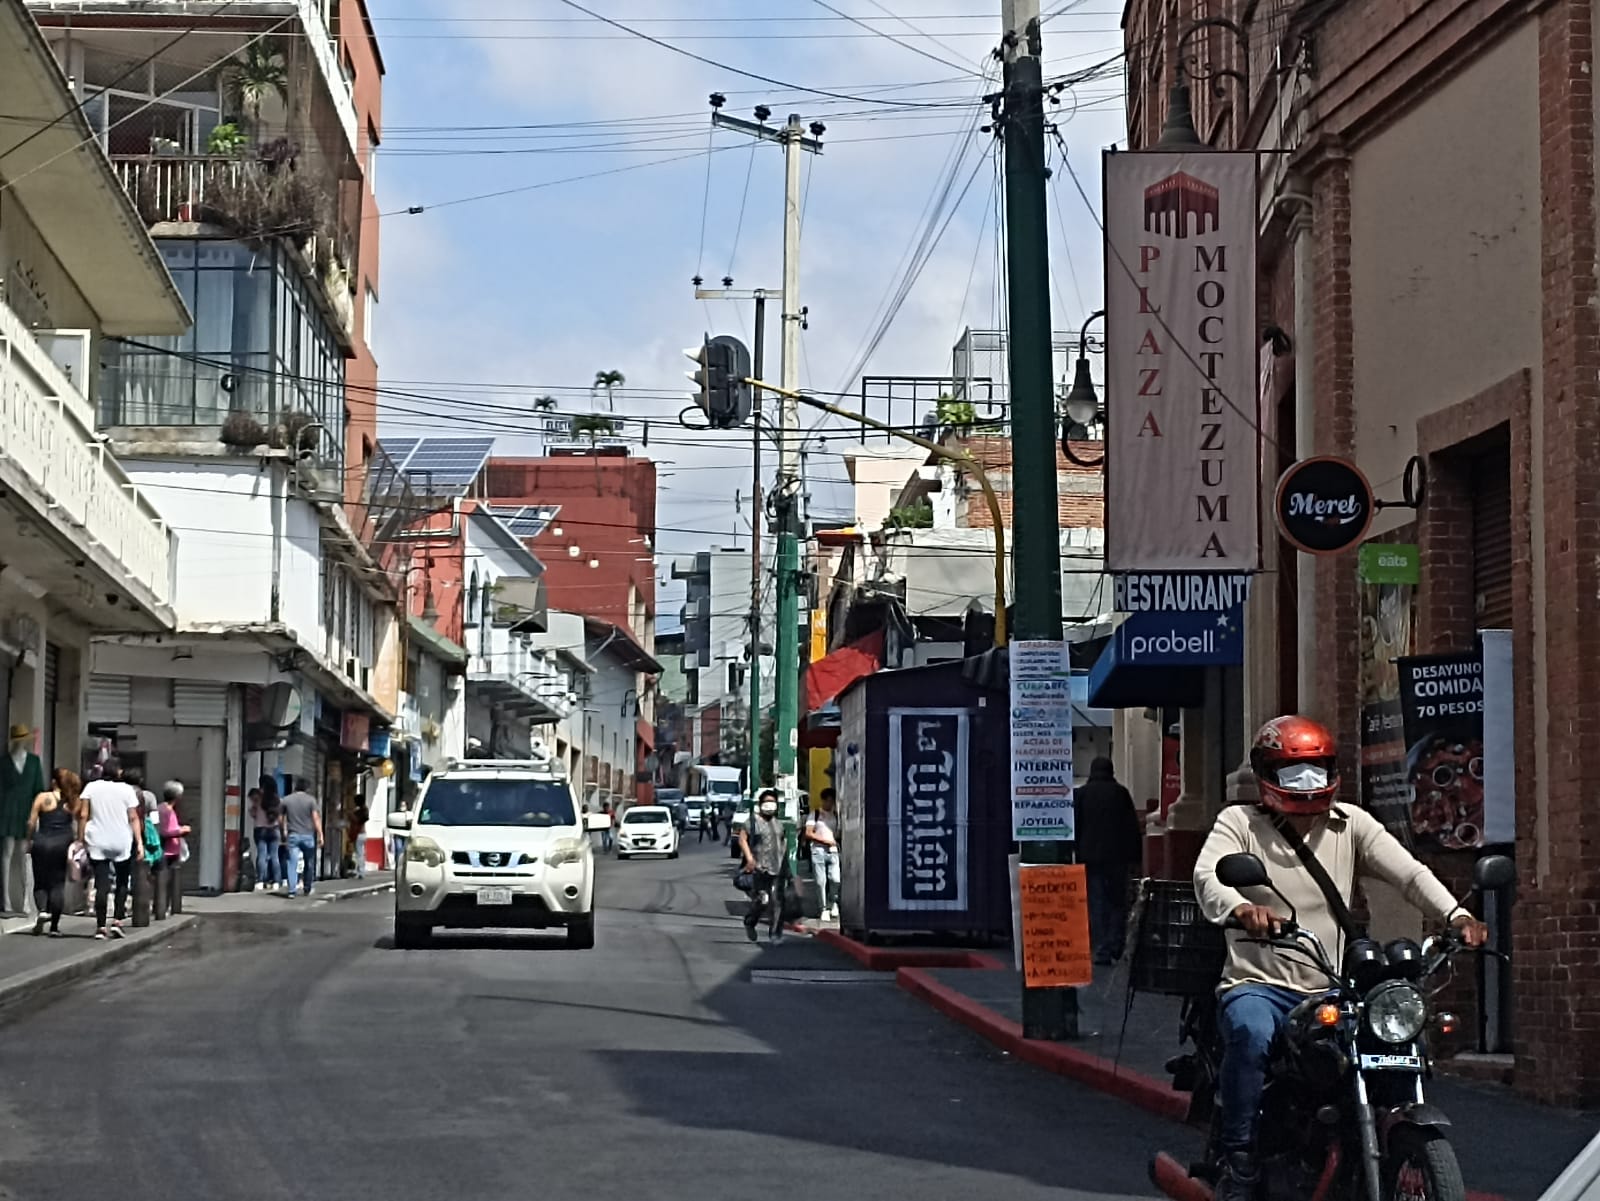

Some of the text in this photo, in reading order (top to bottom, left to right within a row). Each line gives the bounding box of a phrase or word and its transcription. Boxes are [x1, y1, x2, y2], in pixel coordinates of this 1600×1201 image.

[1137, 246, 1164, 438] PLAZA
[1195, 245, 1229, 558] MOCTEZUMA
[1378, 555, 1408, 567] eats
[1131, 629, 1214, 661] probell
[1412, 662, 1482, 680] DESAYUNO
[1414, 677, 1483, 697] COMIDA
[1417, 700, 1484, 718] 70 PESOS
[918, 721, 942, 752] La
[1014, 760, 1072, 772] INTERNET
[1024, 775, 1064, 784] COPIAS
[1021, 817, 1065, 827] JOYERIA
